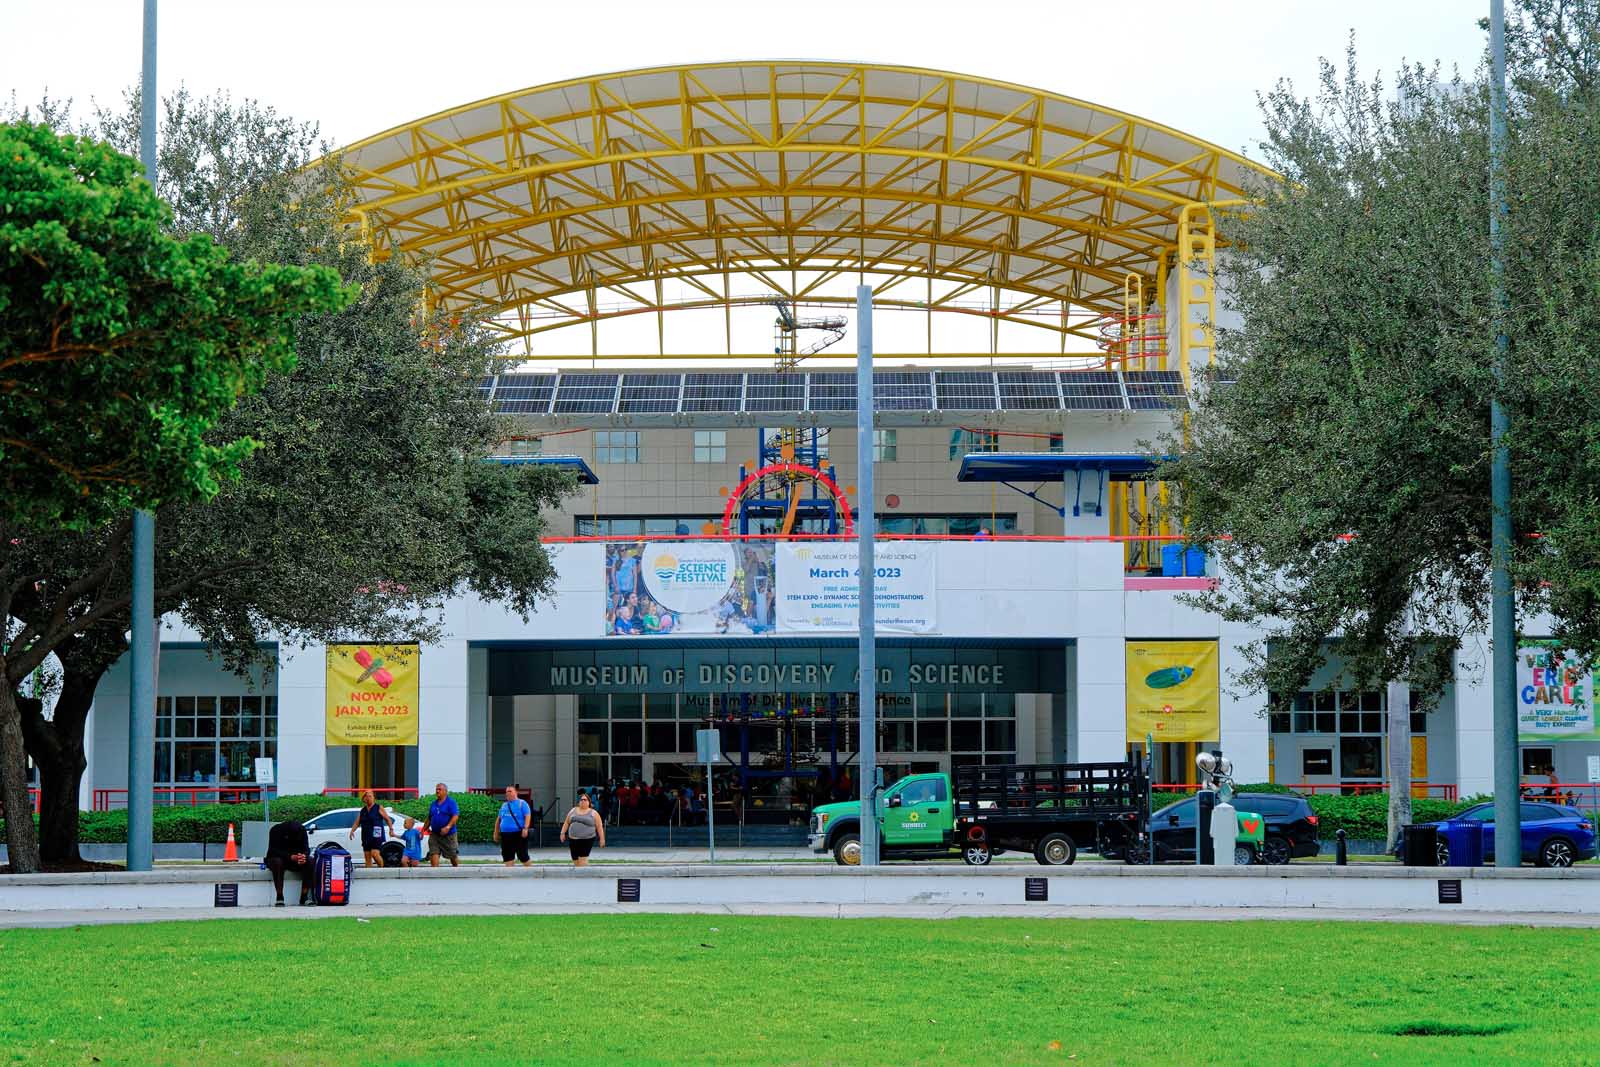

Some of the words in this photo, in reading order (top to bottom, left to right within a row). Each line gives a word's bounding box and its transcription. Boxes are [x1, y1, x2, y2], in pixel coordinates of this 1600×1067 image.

[679, 563, 726, 573] SCIENCE
[809, 567, 849, 578] March
[675, 573, 726, 582] FESTIVAL
[551, 666, 649, 686] MUSEUM
[662, 669, 686, 685] OF
[699, 664, 835, 685] DISCOVERY
[909, 664, 1004, 685] SCIENCE
[1533, 667, 1578, 687] ERIC
[351, 691, 386, 702] NOW
[1521, 684, 1584, 705] CARLE
[335, 705, 364, 717] JAN.
[367, 705, 378, 716] 9,
[382, 705, 409, 715] 2023
